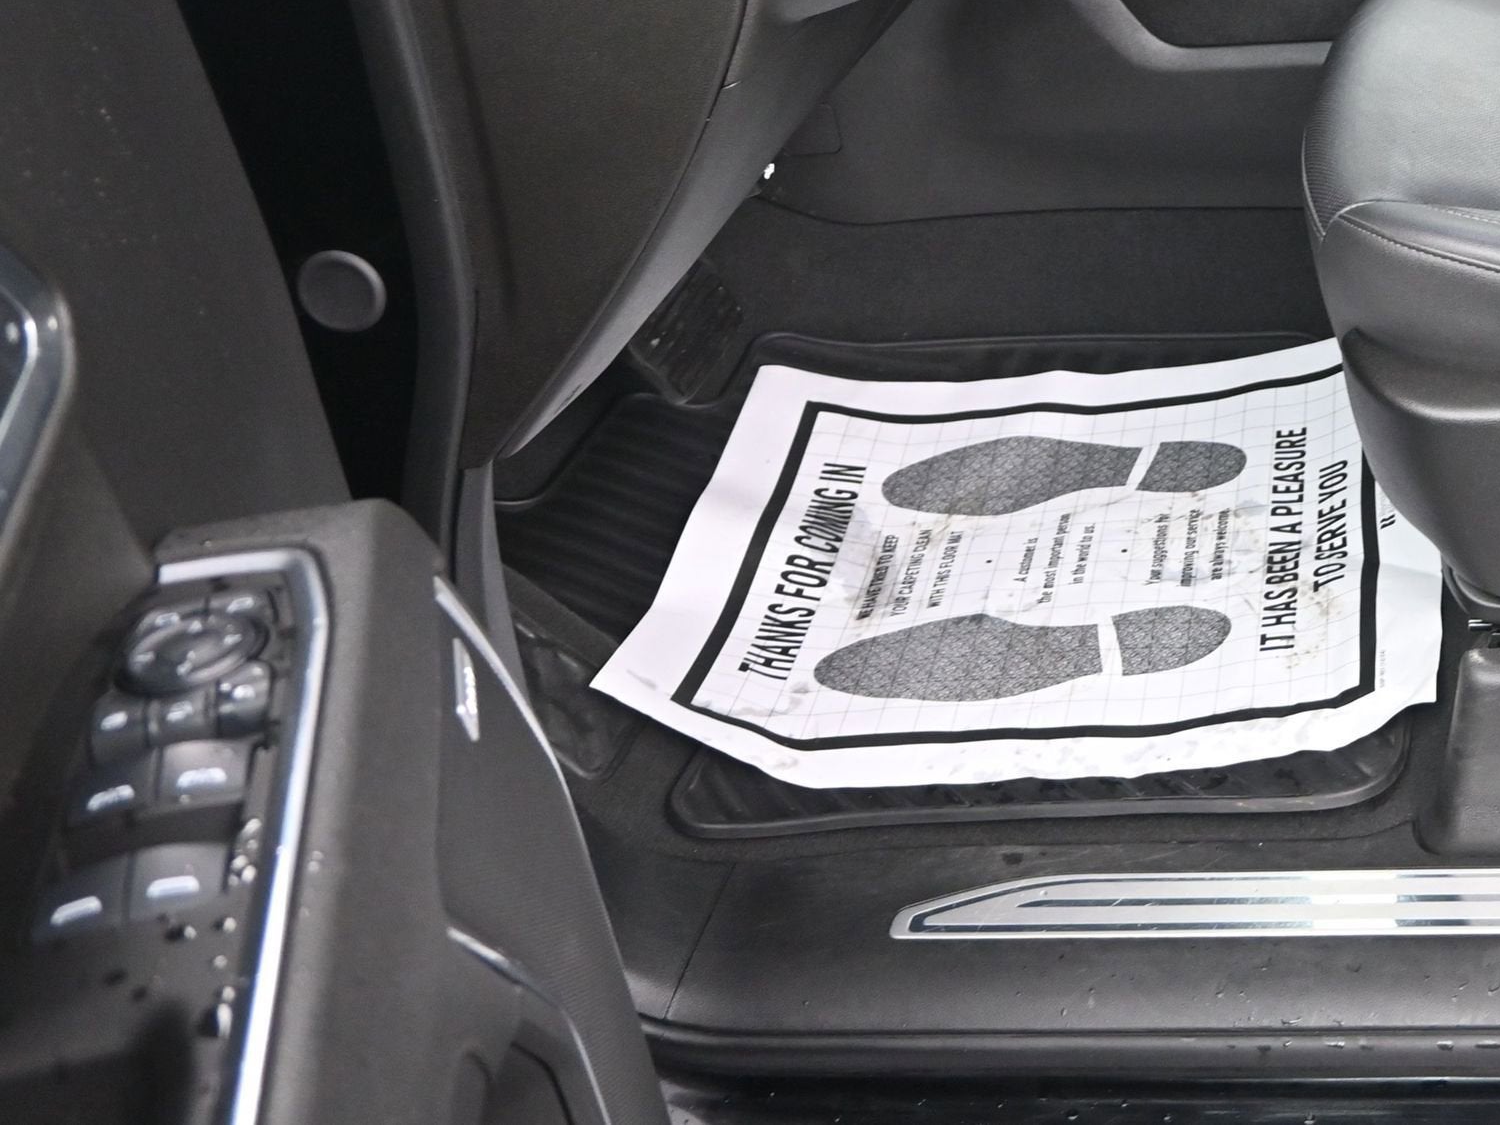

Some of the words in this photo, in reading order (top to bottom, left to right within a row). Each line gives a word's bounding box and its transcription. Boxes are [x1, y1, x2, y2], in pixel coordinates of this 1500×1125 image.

[819, 462, 867, 484] IN
[1270, 427, 1307, 517] PLEASURE
[1317, 460, 1348, 504] YOU
[794, 487, 859, 554] COMING
[1055, 513, 1071, 535] person
[1082, 522, 1096, 534] us.
[1154, 513, 1170, 524] for
[1186, 509, 1201, 536] service
[1213, 508, 1230, 541] welcome.
[1269, 521, 1302, 534] A
[1314, 498, 1348, 561] SERVE
[881, 534, 899, 554] KEEP
[913, 529, 932, 553] CLEAN
[946, 530, 964, 545] MAT
[1023, 536, 1038, 545] is
[1079, 535, 1093, 543] to
[1151, 524, 1168, 568] suggestions
[1185, 536, 1198, 550] our
[876, 553, 894, 566] TO
[939, 544, 958, 569] FLOOR
[1017, 545, 1035, 575] customer
[1045, 535, 1065, 569] important
[1075, 544, 1092, 563] world
[1209, 542, 1227, 567] always
[898, 553, 925, 595] CARPETING
[1071, 563, 1087, 575] the
[1176, 550, 1199, 587] improving
[1210, 567, 1223, 580] are
[1265, 541, 1301, 586] BEEN
[774, 554, 836, 601] FOR
[867, 565, 889, 588] TRIED
[933, 569, 951, 588] THIS
[1042, 570, 1057, 589] most
[1068, 576, 1084, 585] in
[1144, 569, 1162, 586] Your
[1312, 563, 1347, 593] TO
[861, 586, 882, 609] HAVE
[890, 596, 911, 617] YOUR
[926, 588, 945, 609] WITH
[1035, 591, 1052, 604] the
[1261, 587, 1298, 628] HAS
[856, 608, 874, 621] WE
[738, 603, 816, 680] THANKS
[1259, 633, 1295, 652] IT
